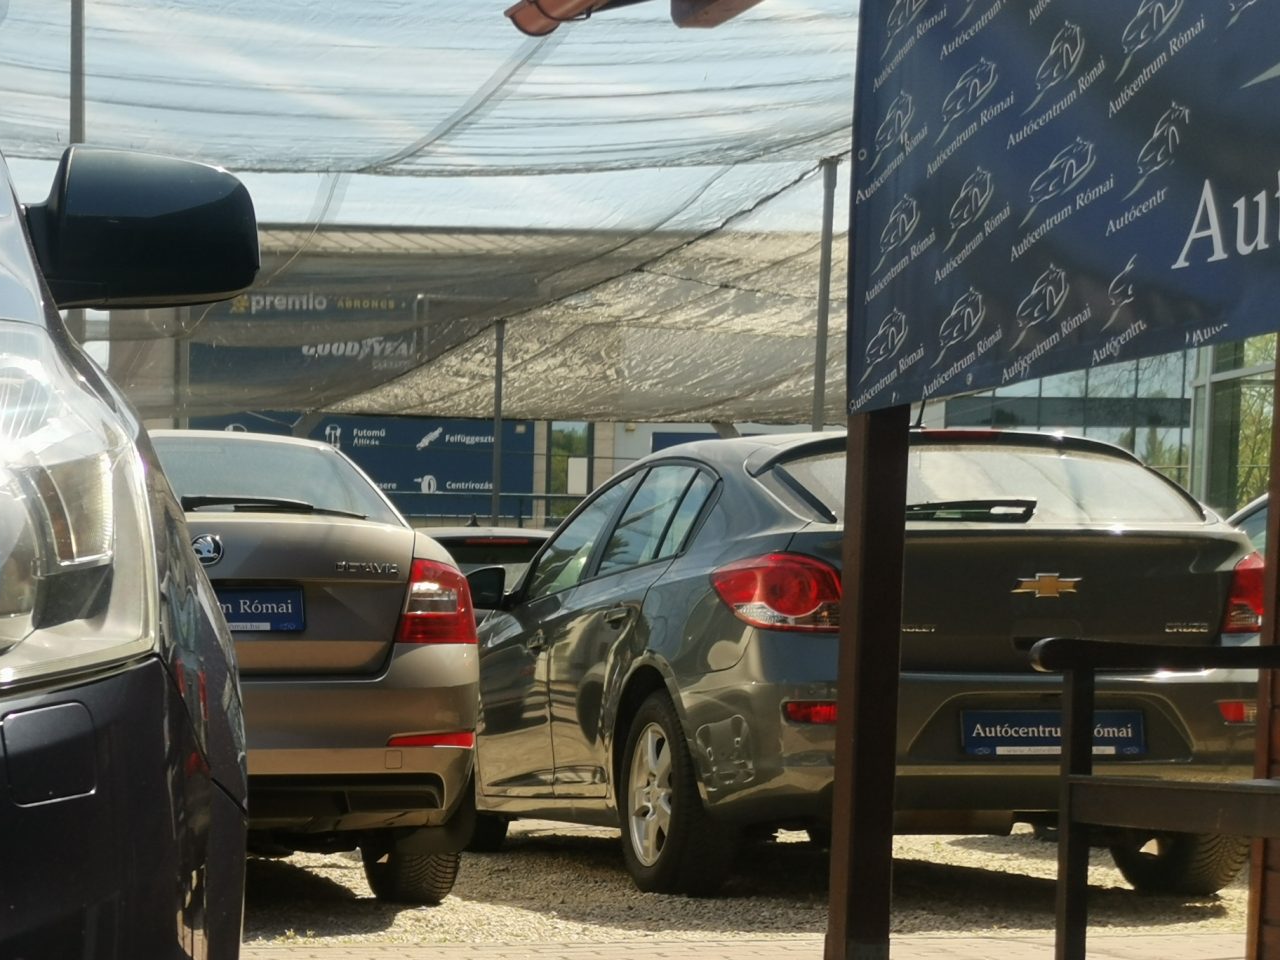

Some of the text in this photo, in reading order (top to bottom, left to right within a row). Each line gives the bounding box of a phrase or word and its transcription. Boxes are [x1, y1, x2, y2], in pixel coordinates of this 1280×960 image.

[1007, 55, 1105, 150] Autócentrum Római
[1108, 13, 1205, 118] Autócentrum Római
[926, 91, 1015, 178] Autócentrum Római
[855, 152, 905, 204] Autócentrum
[1105, 187, 1168, 237] Autócentr
[934, 202, 1011, 284] Autócentrum Római
[1010, 173, 1114, 262] Autócentrum Római
[1171, 167, 1280, 269] Au
[251, 291, 327, 314] premio
[864, 227, 936, 304] Autócentrum Római
[849, 343, 925, 414] Autócentrum Római
[921, 325, 1003, 399] Autócentrum Római
[1001, 303, 1091, 384] Autócentrum Római
[239, 600, 293, 614] Római
[972, 723, 1133, 738] Autócentru ómai
